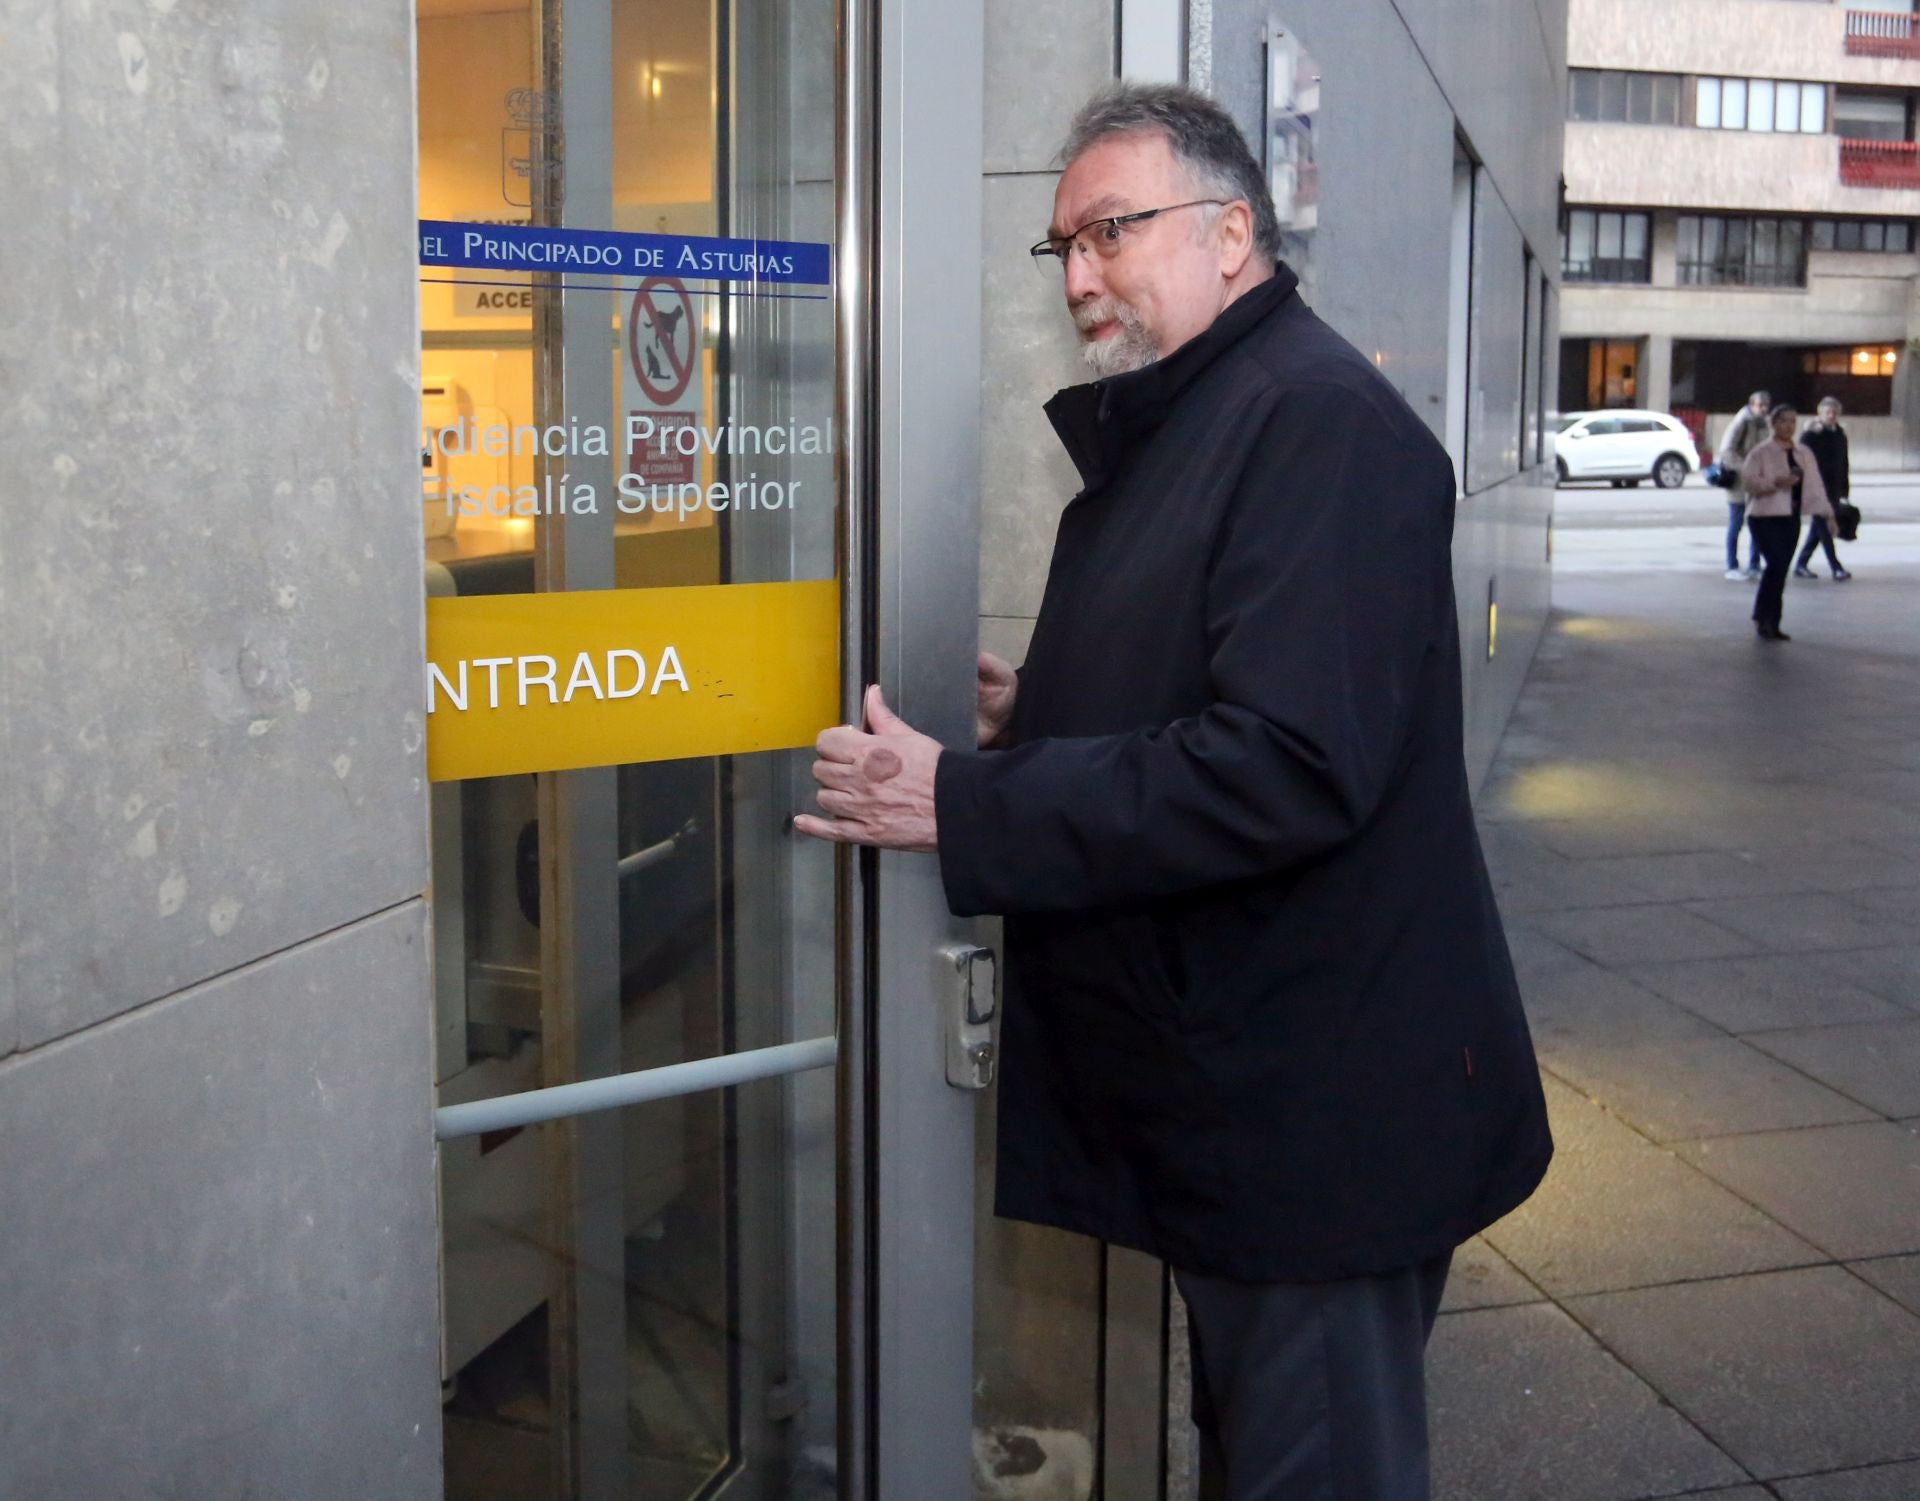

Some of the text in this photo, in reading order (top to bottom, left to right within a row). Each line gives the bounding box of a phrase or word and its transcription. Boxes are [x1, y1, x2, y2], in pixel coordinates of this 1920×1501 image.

[419, 232, 794, 274] EL PRINCIPADO DE ASTURIAS
[626, 416, 832, 456] Provincial
[616, 473, 801, 522] Superior
